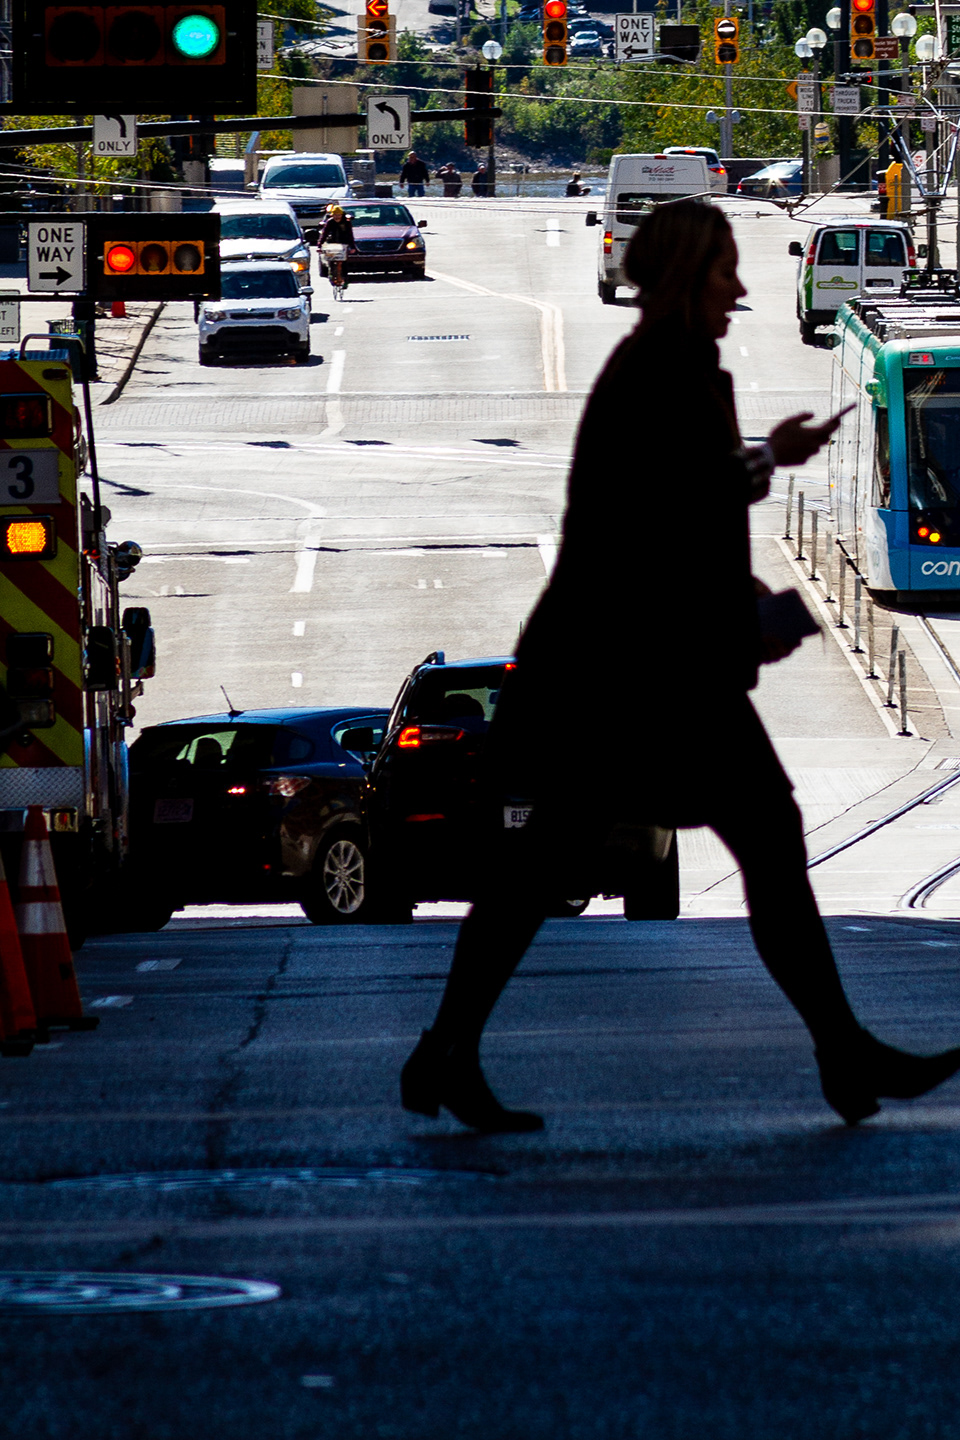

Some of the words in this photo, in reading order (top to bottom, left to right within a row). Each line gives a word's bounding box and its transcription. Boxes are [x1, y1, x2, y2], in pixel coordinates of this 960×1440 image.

[620, 18, 649, 30] ONE
[620, 31, 650, 43] WAY
[372, 134, 405, 145] ONLY
[98, 141, 131, 152] ONLY
[37, 228, 74, 243] ONE
[37, 247, 75, 262] WAY
[0, 326, 15, 336] EFT
[8, 455, 35, 499] 3
